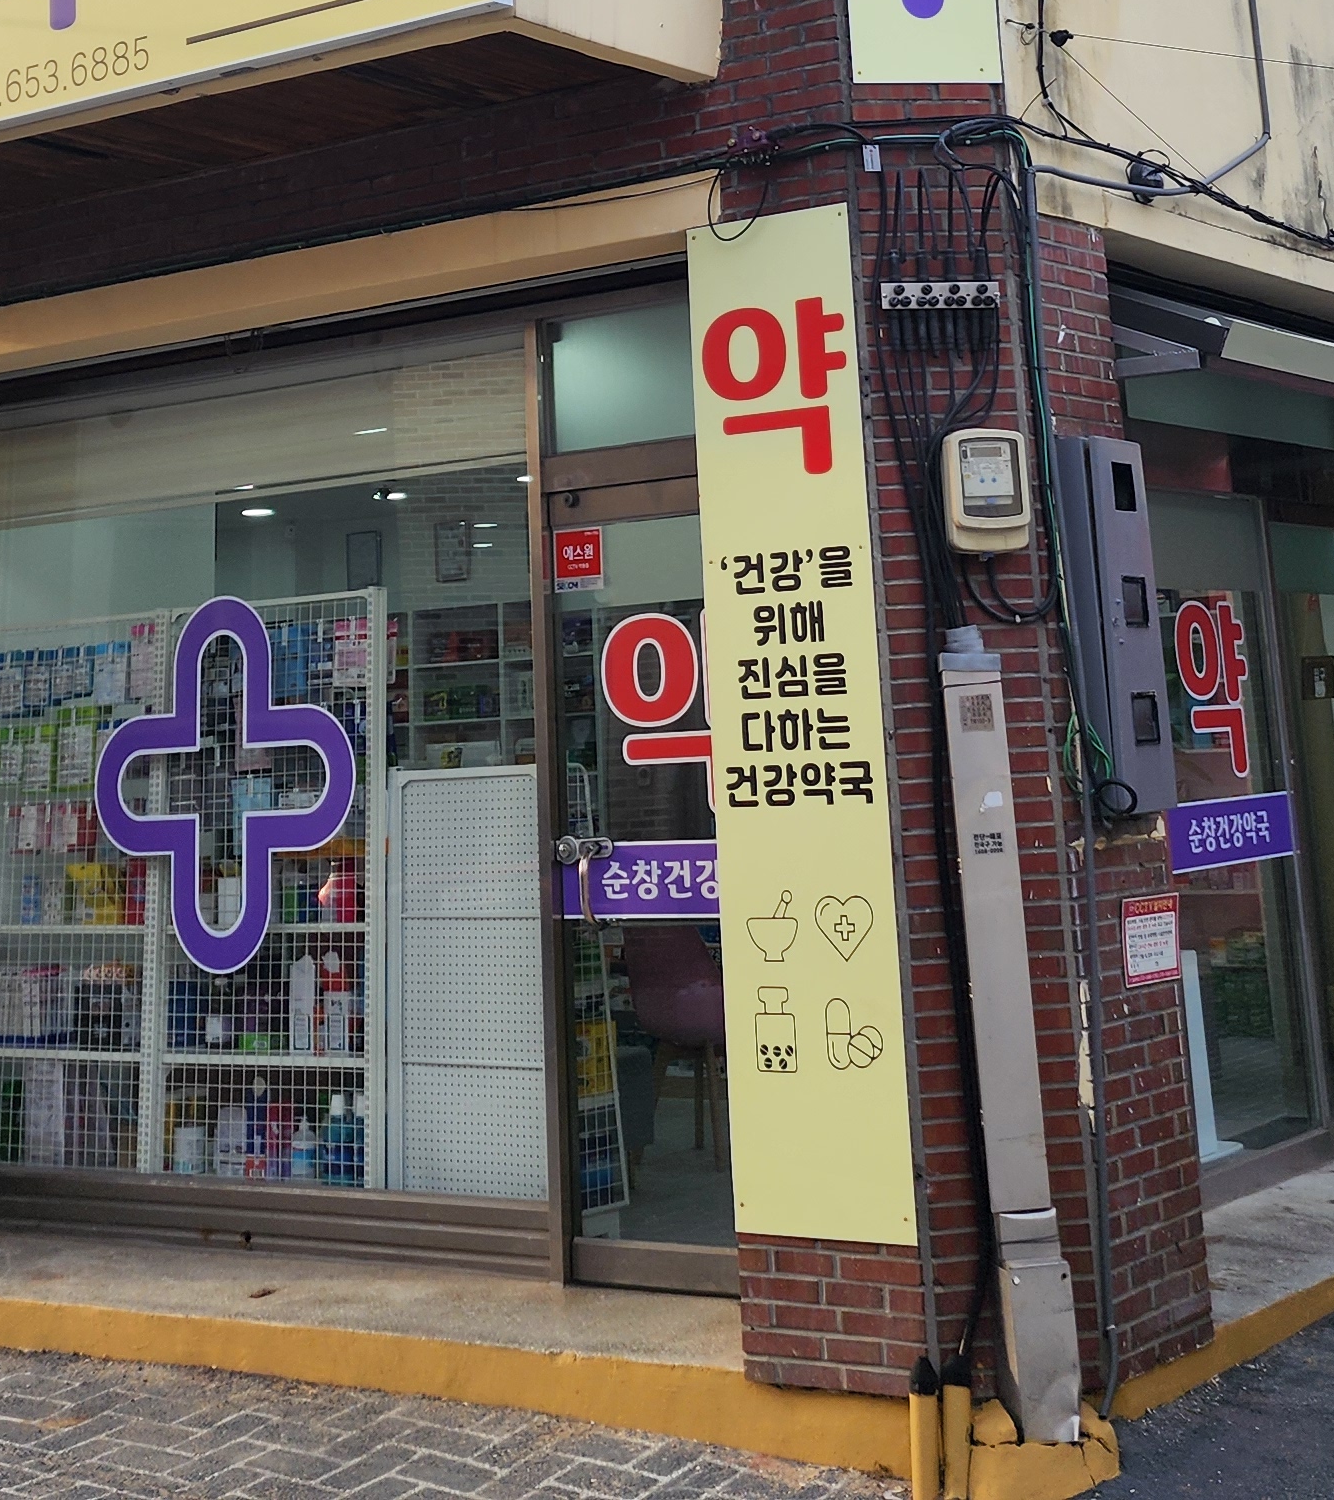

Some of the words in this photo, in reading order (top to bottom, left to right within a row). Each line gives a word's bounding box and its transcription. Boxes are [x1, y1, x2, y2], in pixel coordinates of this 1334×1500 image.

[701, 296, 847, 475] 약
[562, 543, 594, 561] 에스원
[753, 601, 825, 647] 위해
[737, 653, 848, 702] 진심을
[1174, 600, 1248, 778] 약
[741, 707, 850, 753] 다하는
[725, 760, 874, 808] 건강약국
[1188, 809, 1271, 854] 순창건강약국
